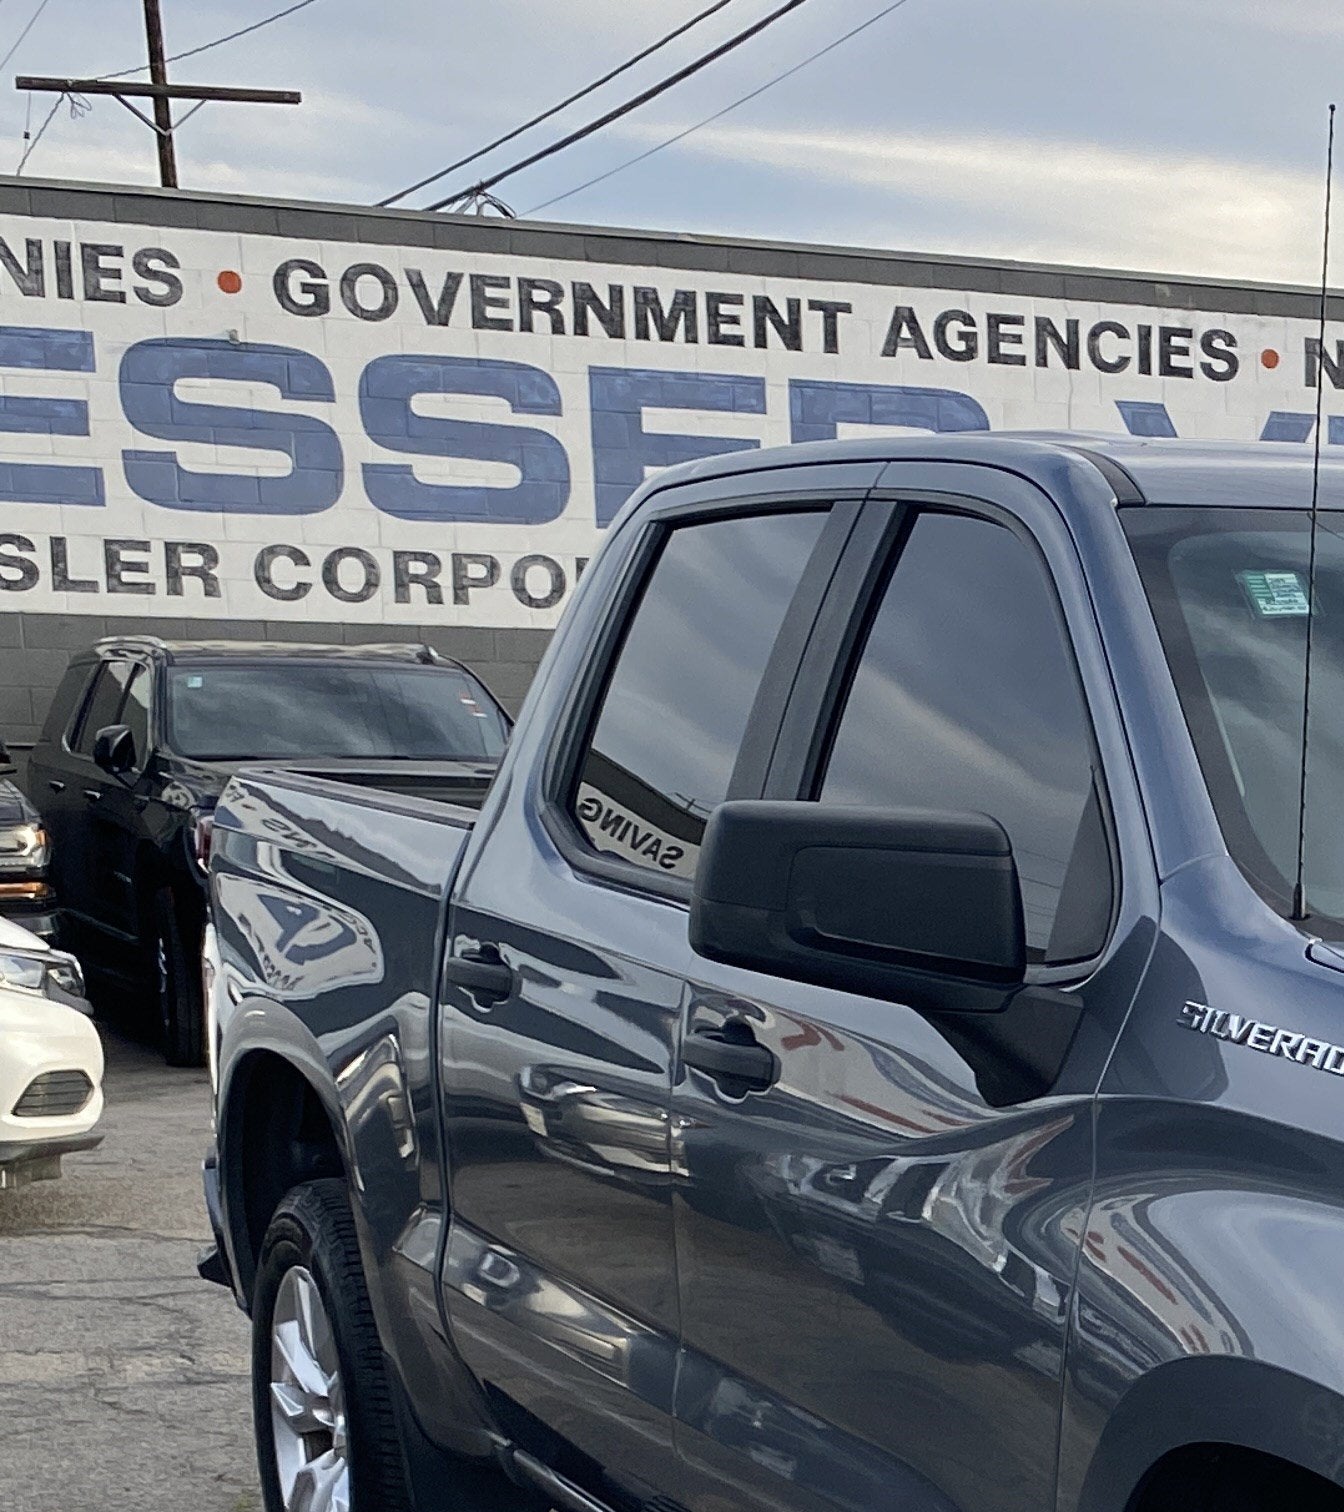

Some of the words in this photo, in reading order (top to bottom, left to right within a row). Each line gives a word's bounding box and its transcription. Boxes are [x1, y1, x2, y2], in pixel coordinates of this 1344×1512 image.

[0, 236, 184, 307] NIES
[272, 258, 853, 355] GOVERNMENT
[881, 304, 1240, 382] AGENCIES
[0, 534, 222, 598] SLER
[253, 545, 591, 610] CORPO
